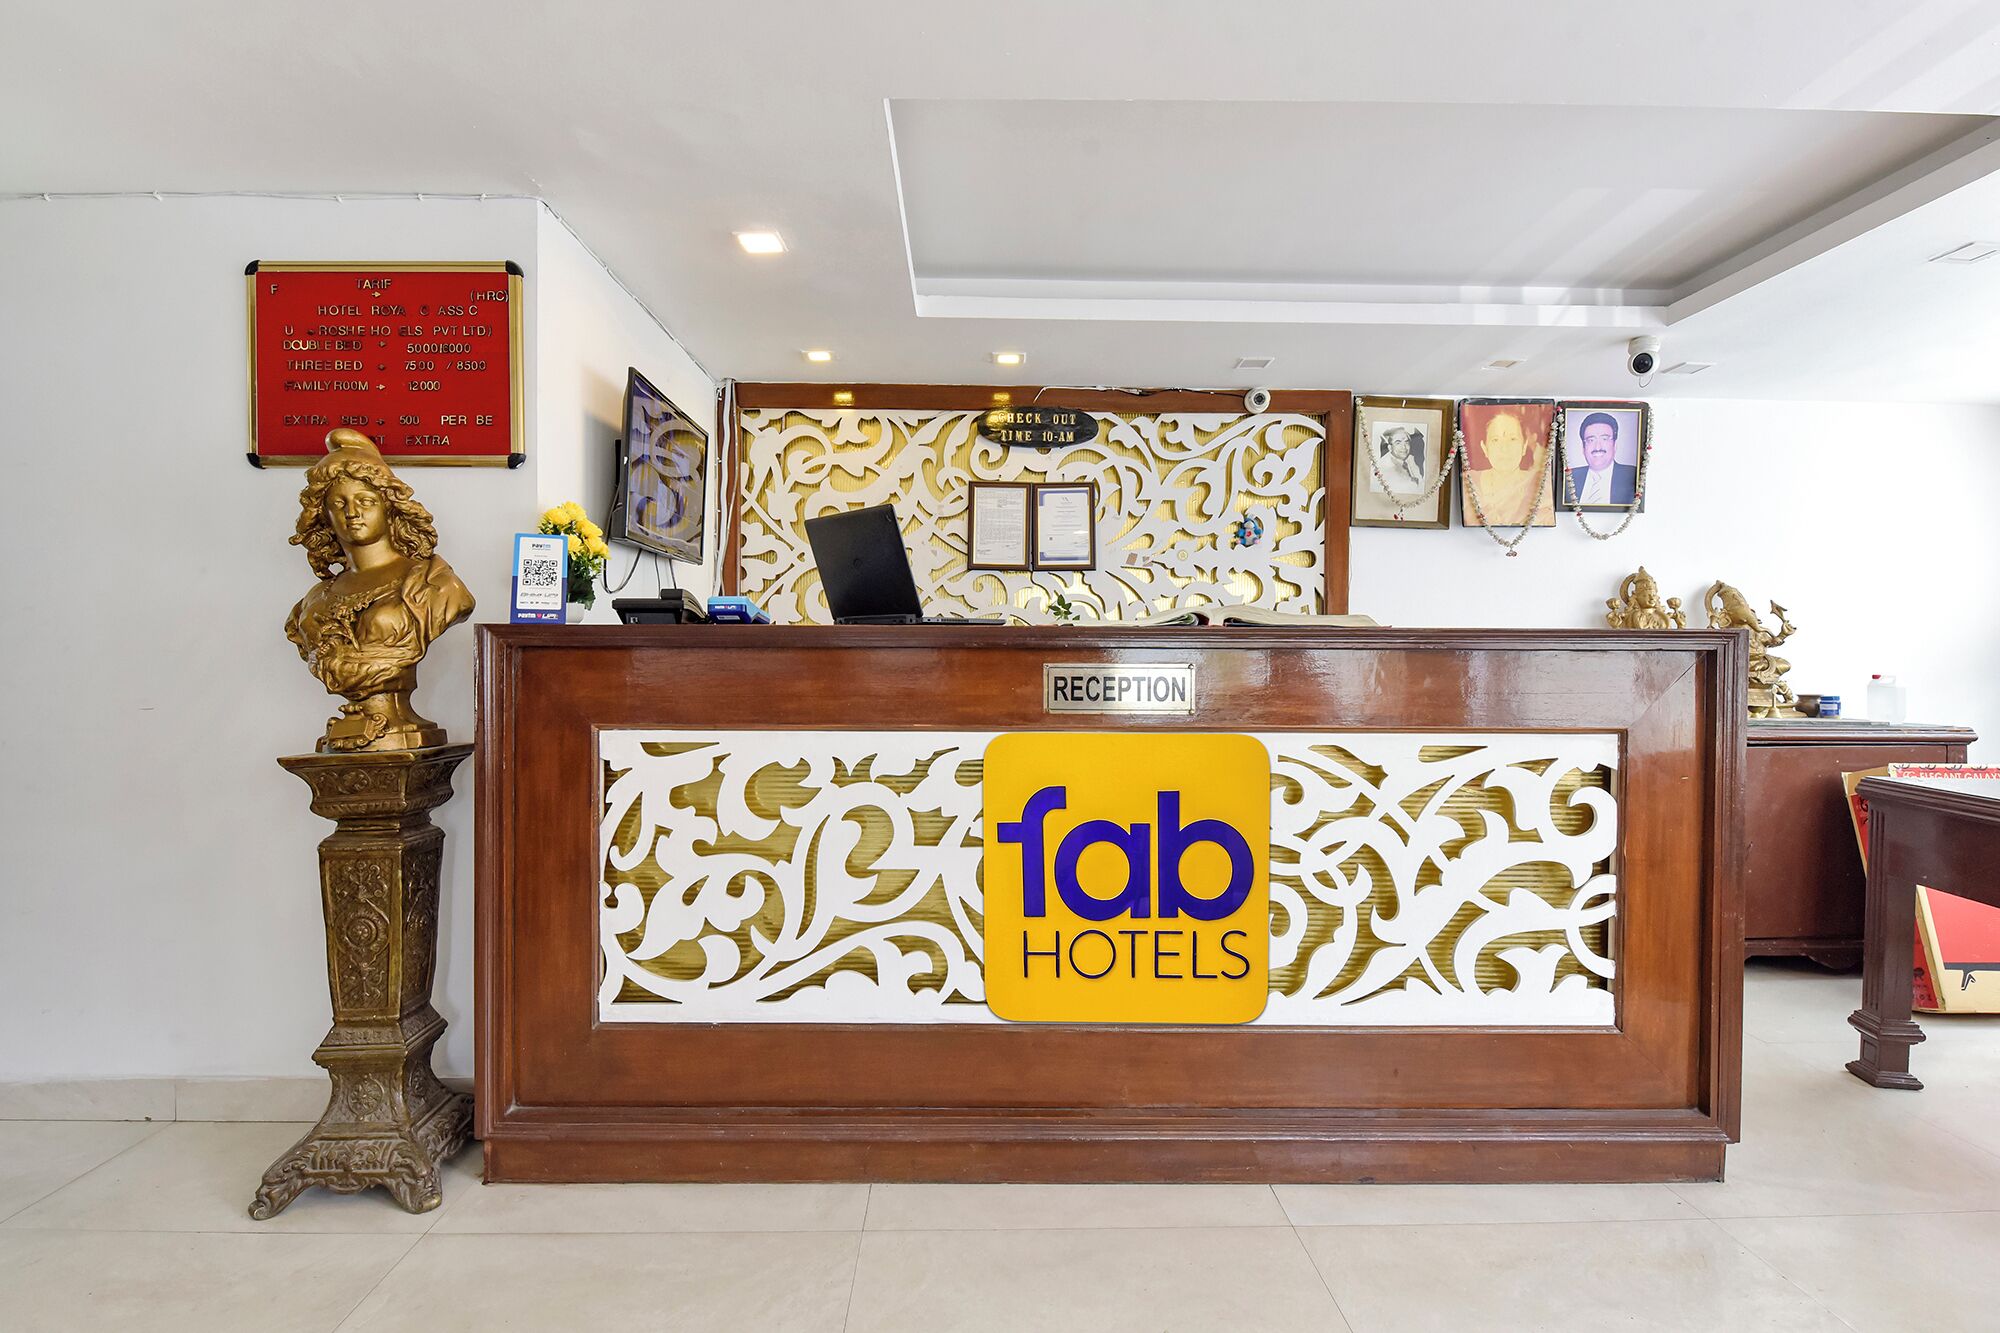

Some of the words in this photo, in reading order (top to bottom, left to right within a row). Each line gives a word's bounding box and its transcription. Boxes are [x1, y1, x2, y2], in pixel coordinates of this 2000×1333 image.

[355, 279, 391, 289] TARIF
[469, 290, 509, 302] (HRC)
[318, 305, 362, 316] HOTEL
[433, 325, 457, 336] PVT
[283, 340, 332, 351] DOUBLE
[335, 340, 361, 351] BED
[288, 360, 333, 371] THREE
[334, 360, 363, 371] BED
[404, 360, 434, 371] 7500
[456, 360, 486, 371] 8500
[284, 381, 331, 391] FAMILY
[334, 381, 369, 391] ROOM
[408, 380, 441, 391] 12000
[283, 415, 329, 425] EXTRA
[341, 415, 369, 426] BED
[399, 415, 420, 425] 500
[440, 415, 468, 426] PER
[998, 413, 1042, 424] CHECK
[1053, 414, 1077, 425] OUT
[405, 435, 450, 446] EXTRA
[1000, 431, 1032, 442] TIME
[1042, 431, 1075, 442] 10-AM
[1053, 676, 1186, 702] RECEPTION
[997, 786, 1254, 921] fab
[1023, 929, 1250, 980] HOTELS
